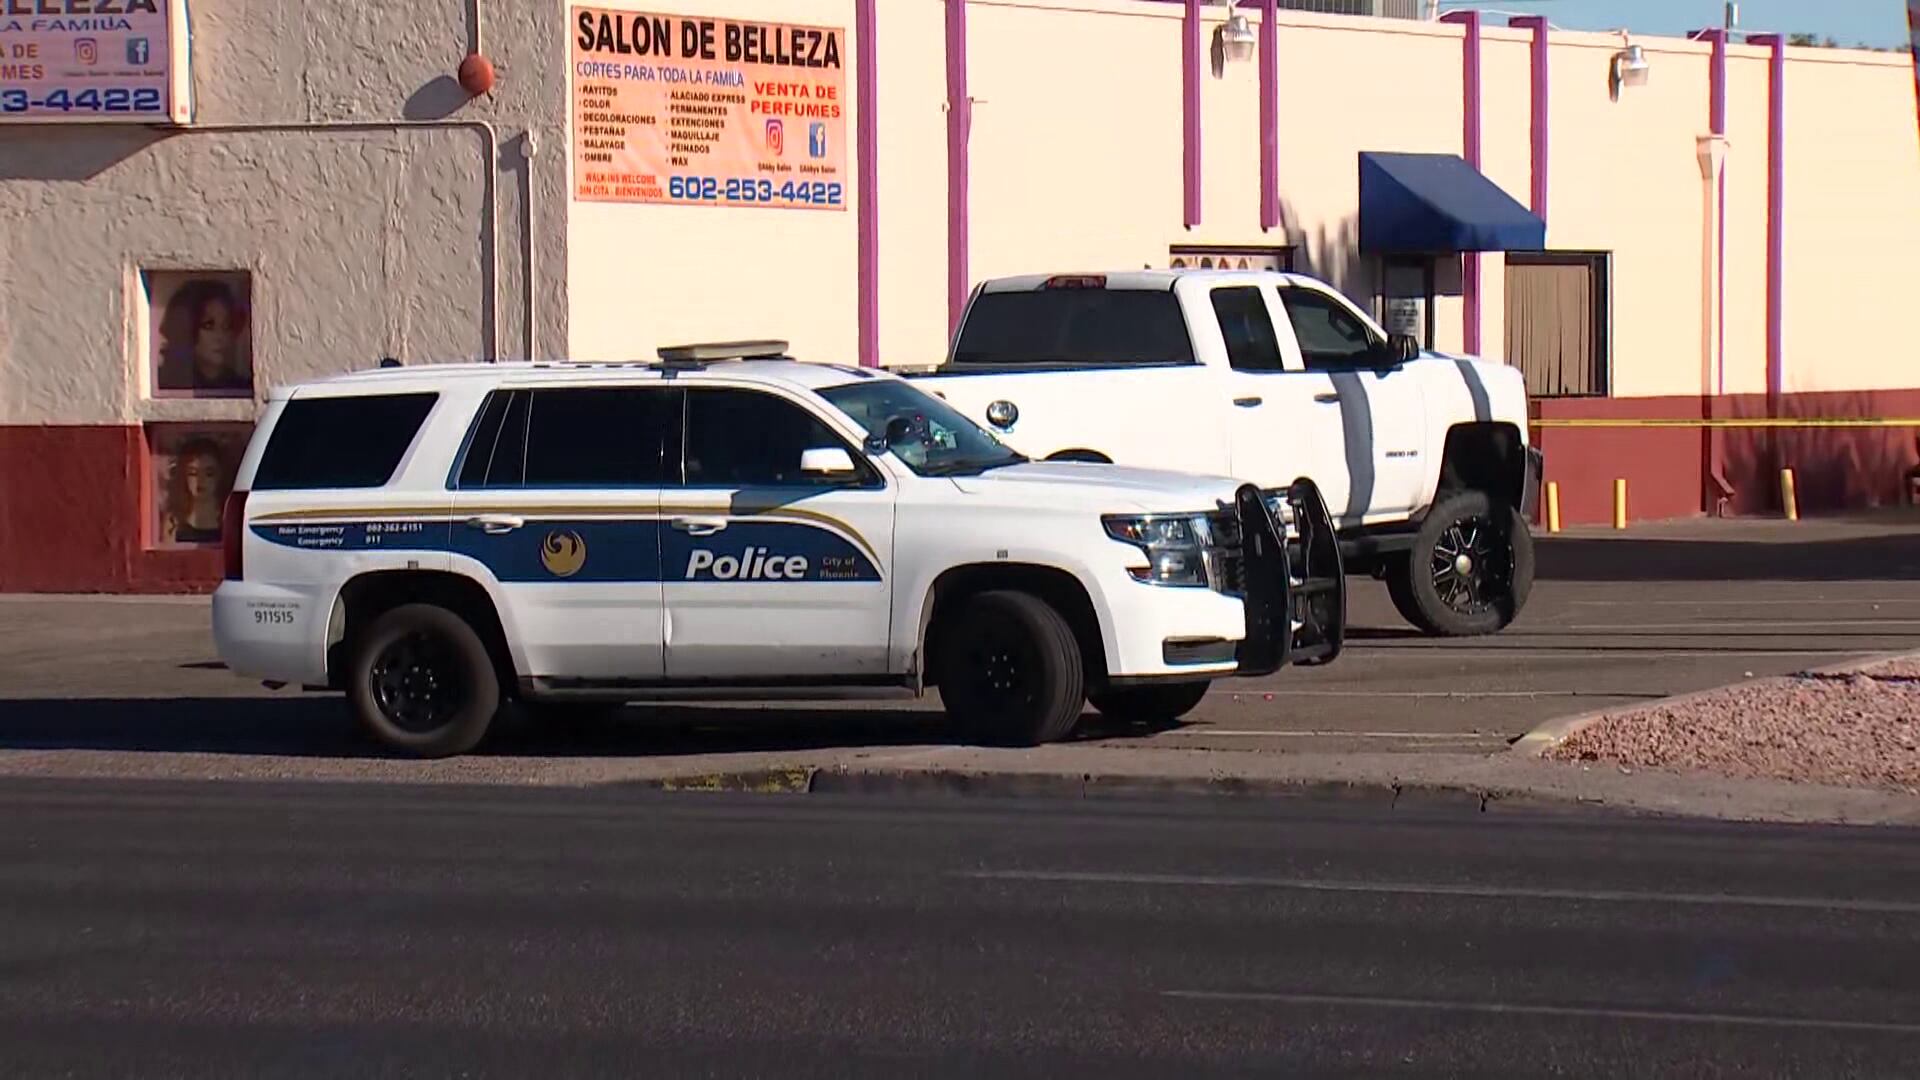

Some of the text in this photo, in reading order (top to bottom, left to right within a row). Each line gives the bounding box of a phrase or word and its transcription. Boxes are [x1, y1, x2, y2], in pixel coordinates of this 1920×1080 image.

[0, 0, 158, 14] LLEZA
[578, 11, 840, 69] SALON DE BELLEZA
[12, 44, 39, 58] DE
[576, 61, 621, 79] CORTES
[625, 65, 655, 81] PARA
[657, 67, 687, 83] TODA
[689, 69, 703, 84] LA
[583, 85, 618, 96] RAYITOS
[754, 81, 836, 100] VENTA DE
[2, 88, 161, 112] 3-4422
[671, 91, 746, 104] ALACIADO EXPRESS
[583, 99, 611, 109] COLOR
[671, 104, 728, 116] PERMANENTES
[751, 100, 840, 118] PERFUMES
[583, 113, 656, 125] DECOLORACIONES
[671, 117, 725, 128] EXTENCIONES
[671, 130, 720, 142] MAQUILLAJE
[584, 139, 625, 150] BALAYAGE
[671, 143, 710, 154] PEINADOS
[584, 153, 613, 163] OMBRE
[671, 156, 689, 167] WAX
[622, 174, 657, 185] WELCOME
[593, 185, 609, 196] CITA
[615, 186, 663, 198] BIENVENIDOS
[669, 175, 841, 204] 602-253-4422
[298, 526, 345, 537] Emergency
[298, 537, 344, 546] Emergency
[685, 546, 809, 580] Police
[822, 556, 856, 568] City of
[255, 610, 294, 624] 911515
